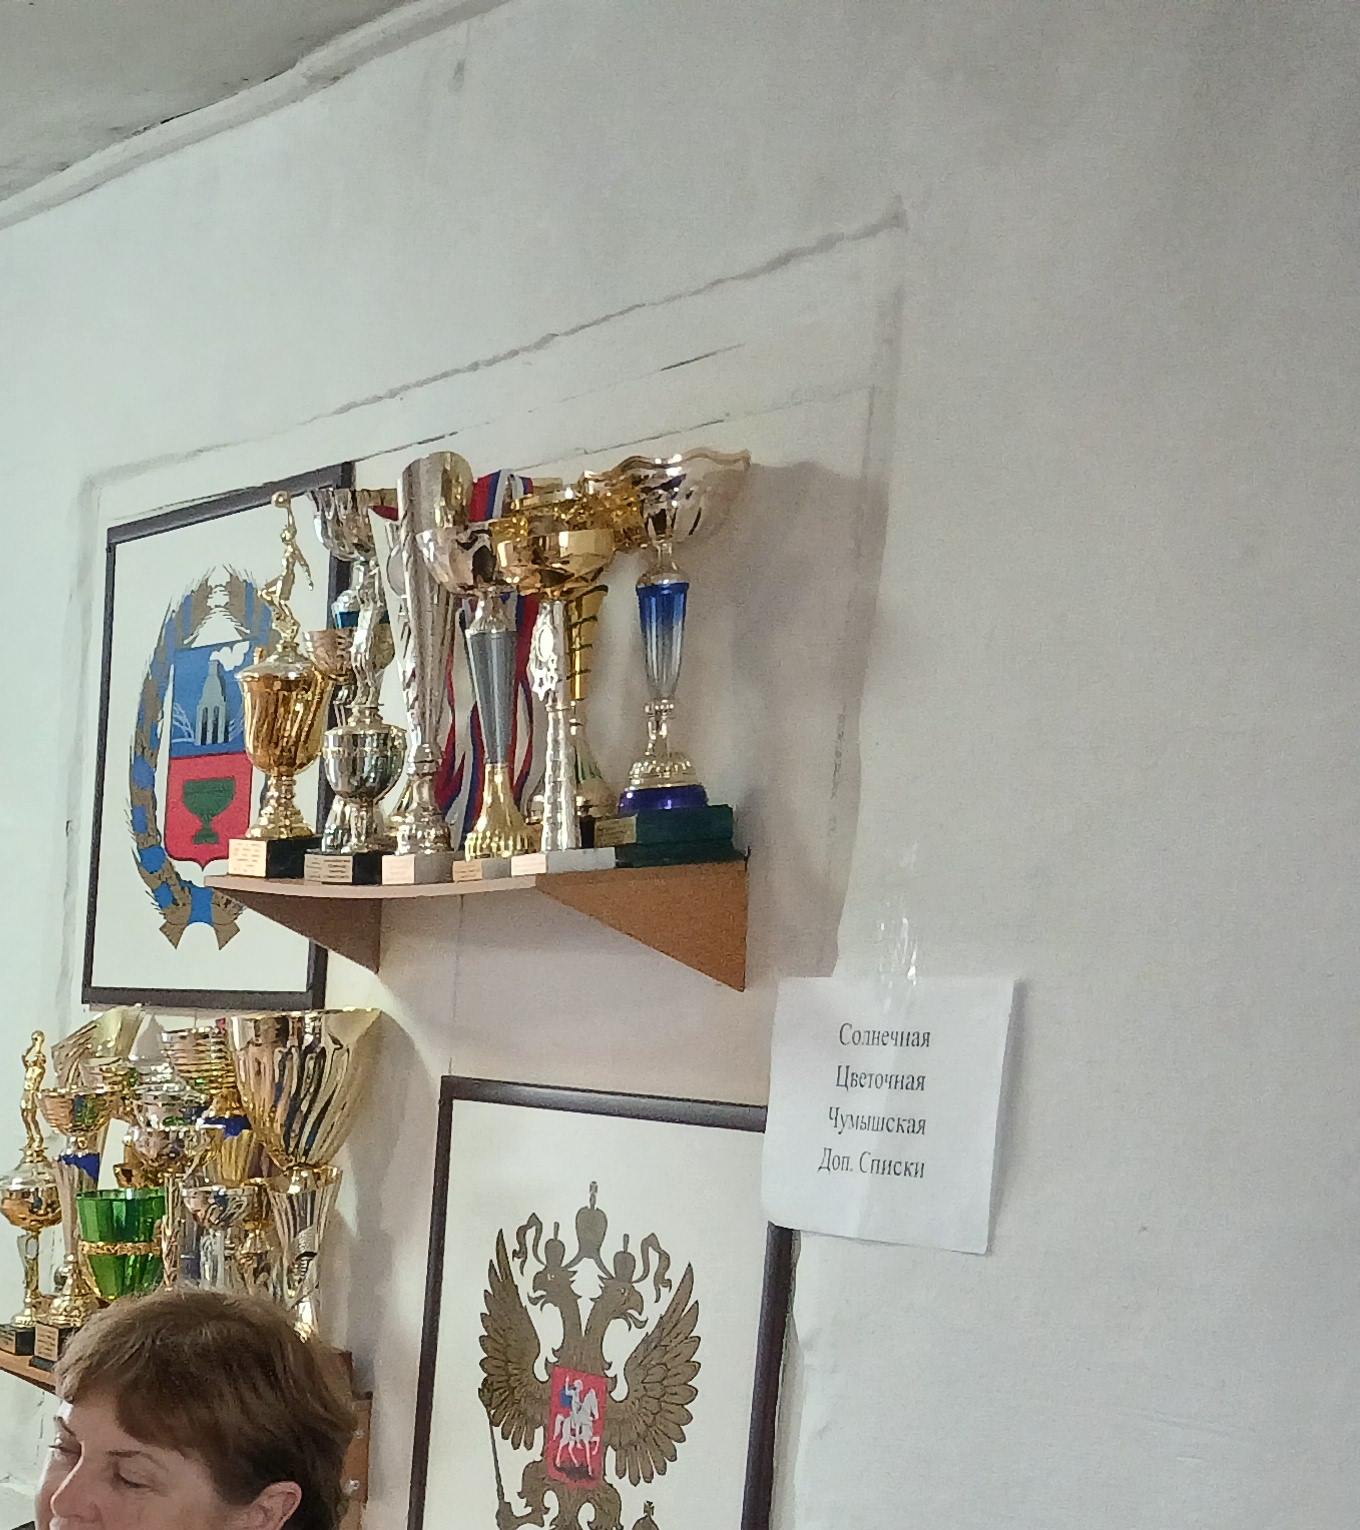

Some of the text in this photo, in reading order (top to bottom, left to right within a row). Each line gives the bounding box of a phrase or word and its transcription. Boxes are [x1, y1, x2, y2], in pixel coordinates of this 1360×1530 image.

[838, 1022, 931, 1048] Солнечная
[835, 1065, 927, 1092] Цветочная
[828, 1106, 927, 1135] Чумышская
[817, 1147, 925, 1179] Доп. Списки
